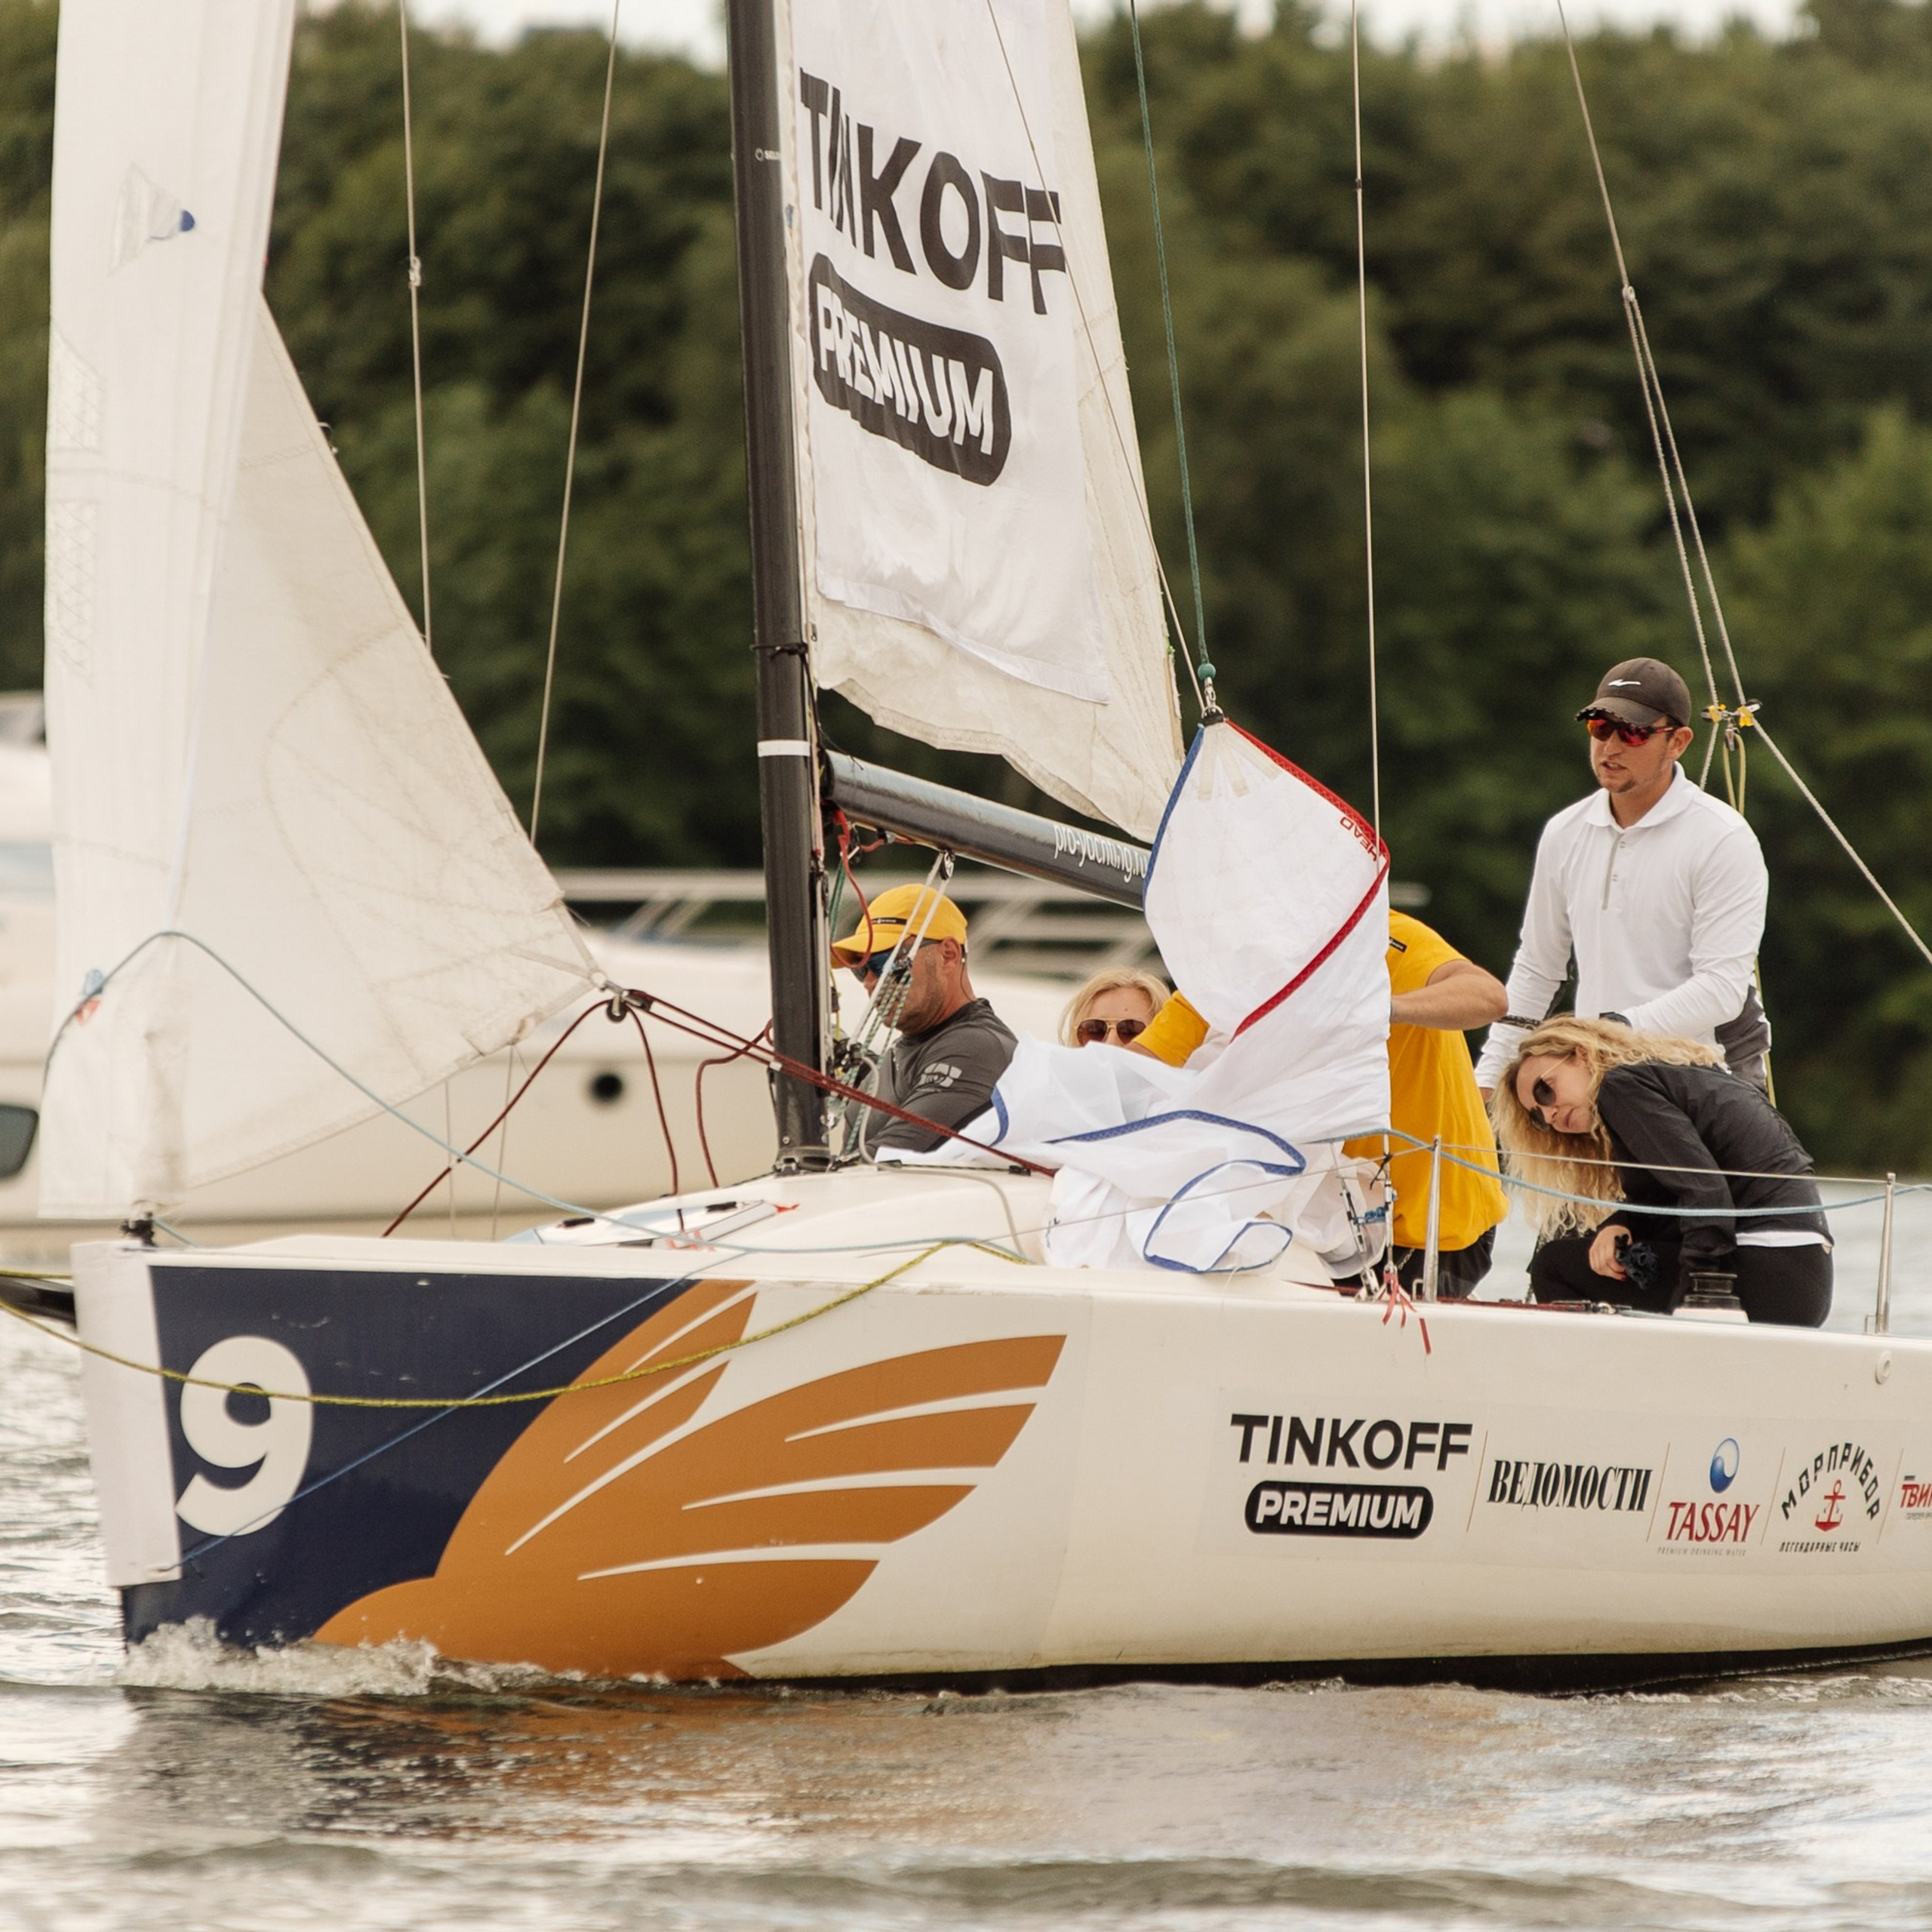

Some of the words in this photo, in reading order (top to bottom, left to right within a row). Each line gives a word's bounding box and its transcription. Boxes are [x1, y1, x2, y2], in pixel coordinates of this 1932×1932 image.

[817, 281, 994, 455] PREMIUM
[1054, 824, 1147, 883] pro-yachting.ru
[1340, 817, 1377, 862] HEAD
[174, 1335, 313, 1537] 9
[1230, 1414, 1473, 1471] TINKOFF
[1487, 1460, 1653, 1512] ВЕДОМОСТИ
[1781, 1442, 1881, 1521] МОРПРИБОР
[1256, 1490, 1423, 1529] PREMIUM
[1666, 1502, 1761, 1543] TASSAY
[1657, 1546, 1688, 1555] PREMIUM
[1726, 1549, 1746, 1557] WATER
[1779, 1541, 1837, 1553] ЛЕГЕНДАРНЫЕ
[1839, 1541, 1861, 1552] ЧАСЫ
